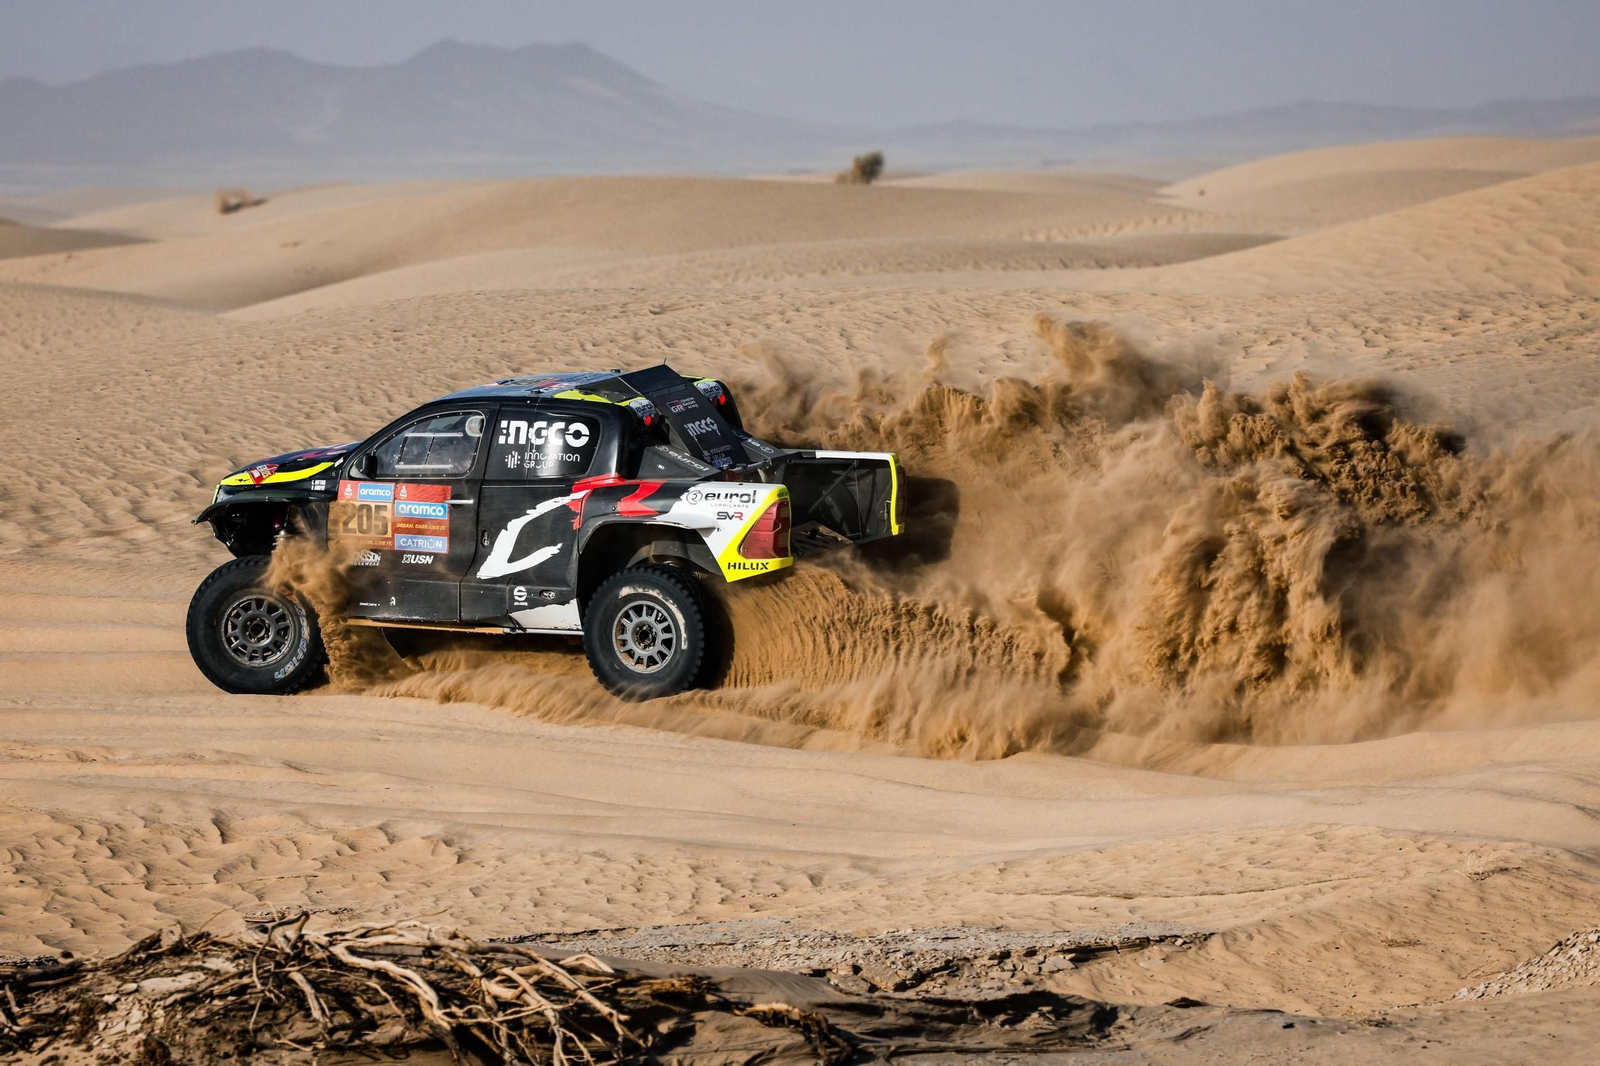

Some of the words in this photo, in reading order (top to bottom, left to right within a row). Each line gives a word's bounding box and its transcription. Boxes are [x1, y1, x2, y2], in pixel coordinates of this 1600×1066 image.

[635, 402, 653, 412] eurol
[524, 452, 580, 462] INNOVATION
[668, 452, 709, 471] eurol
[523, 460, 554, 469] GROUP
[360, 489, 391, 497] aramco
[704, 490, 757, 503] eurol
[399, 504, 444, 516] aramco
[342, 503, 389, 536] 205
[716, 511, 744, 521] SVR
[400, 538, 443, 549] CATRION
[410, 555, 434, 565] USN
[728, 562, 770, 571] HILUX
